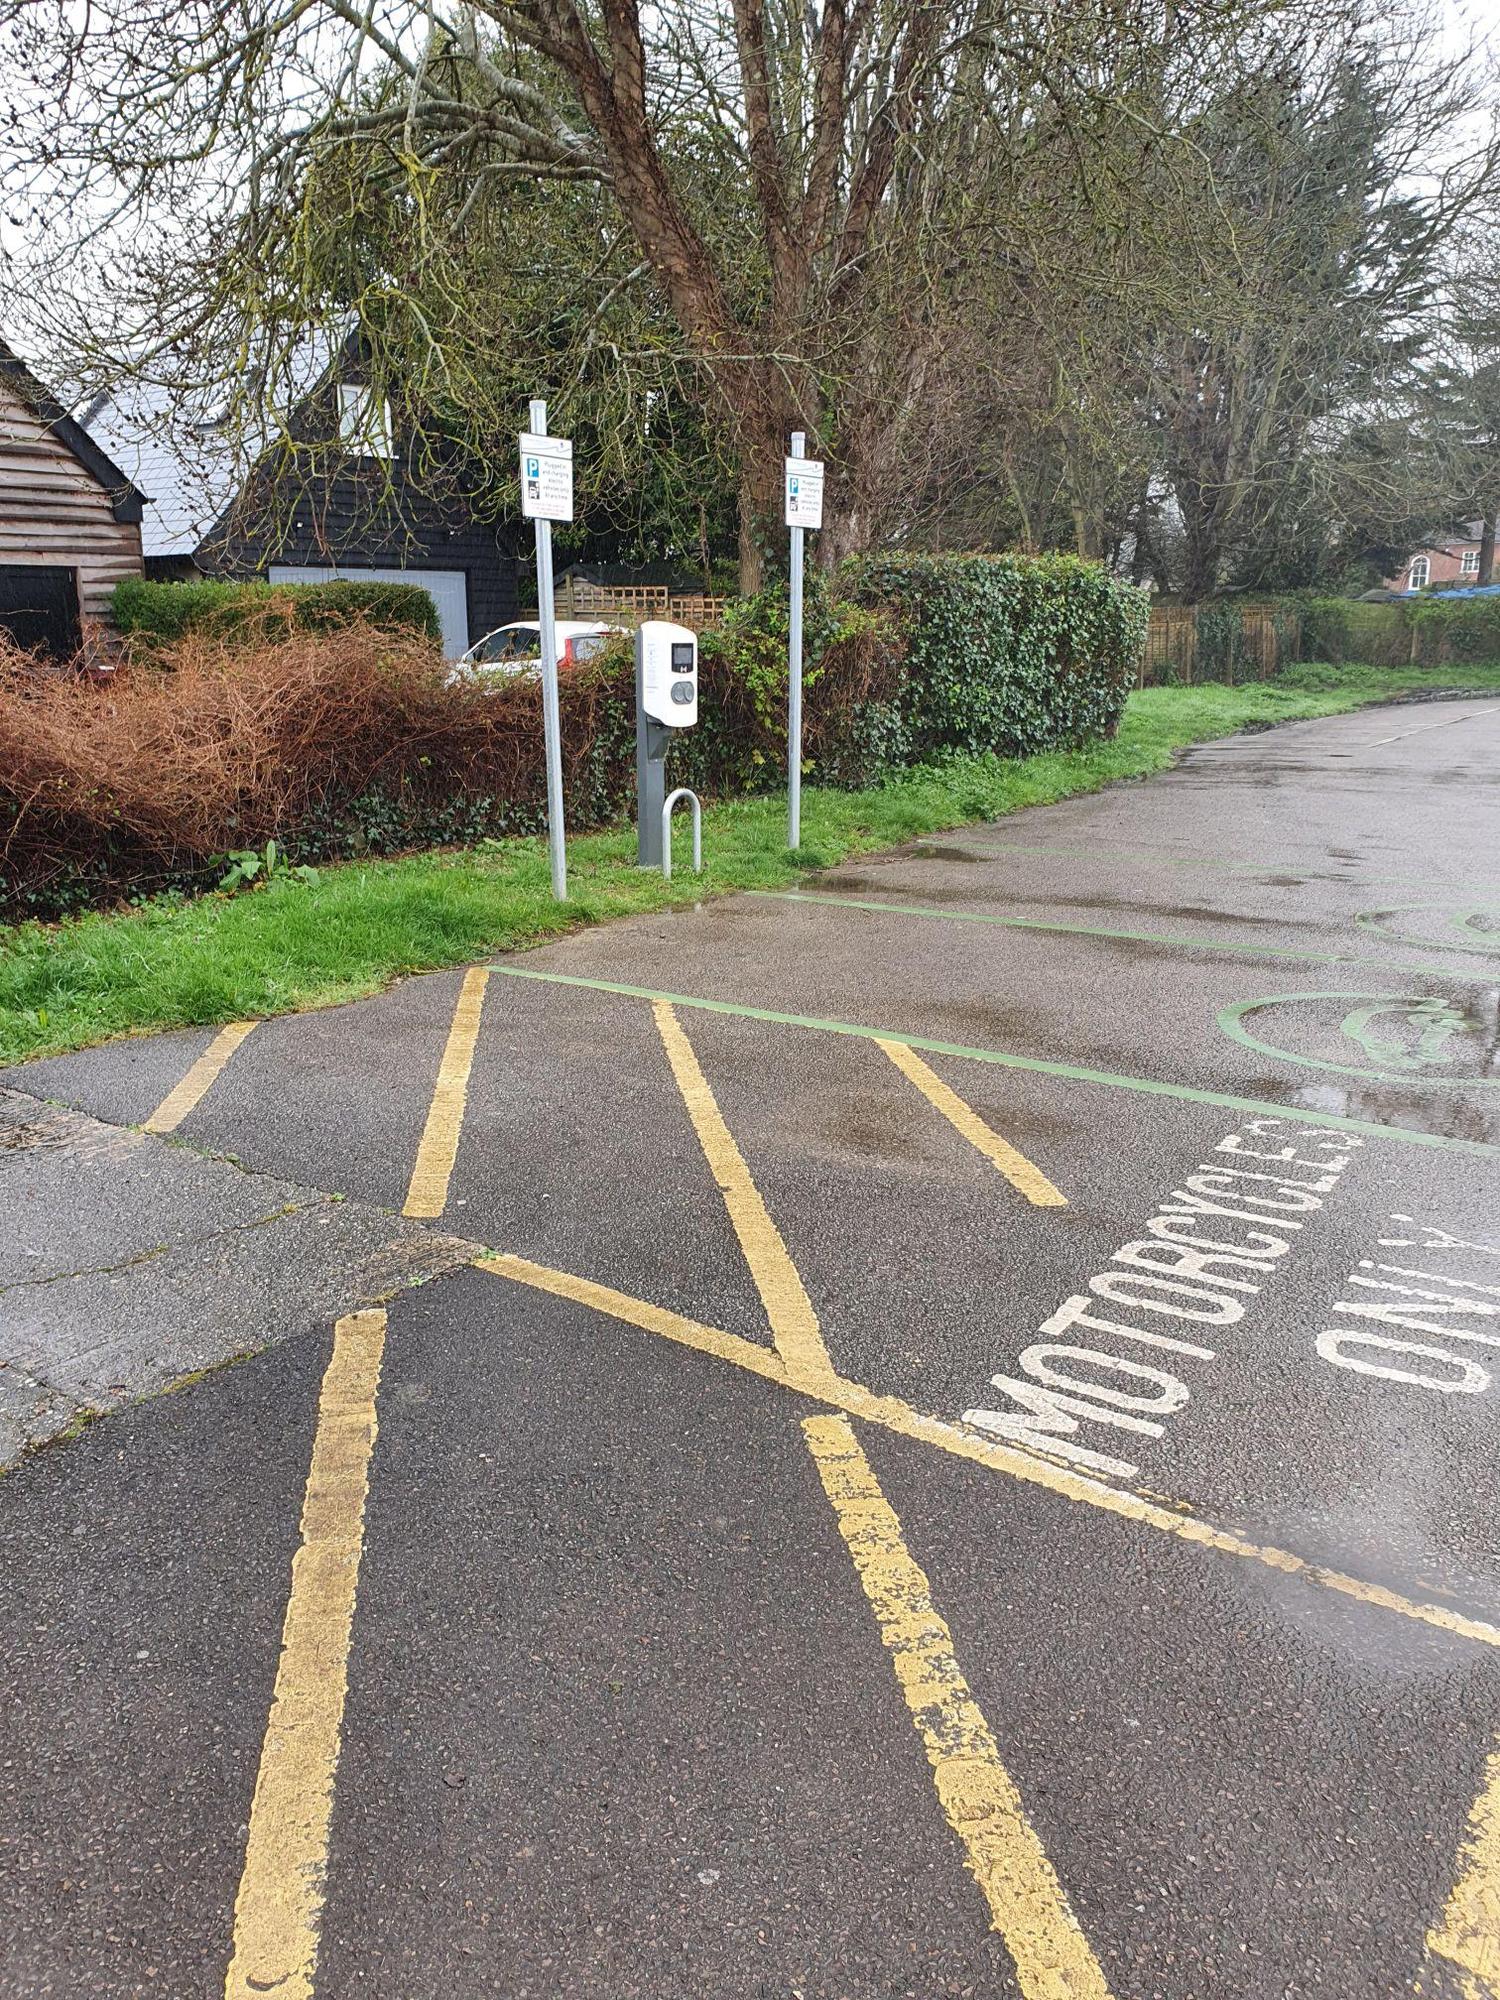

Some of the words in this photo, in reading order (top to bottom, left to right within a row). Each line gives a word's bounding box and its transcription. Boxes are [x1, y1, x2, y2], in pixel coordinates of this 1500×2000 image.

[528, 459, 538, 477] P
[791, 478, 798, 493] P
[961, 1119, 1366, 1478] MOTORCYCLES
